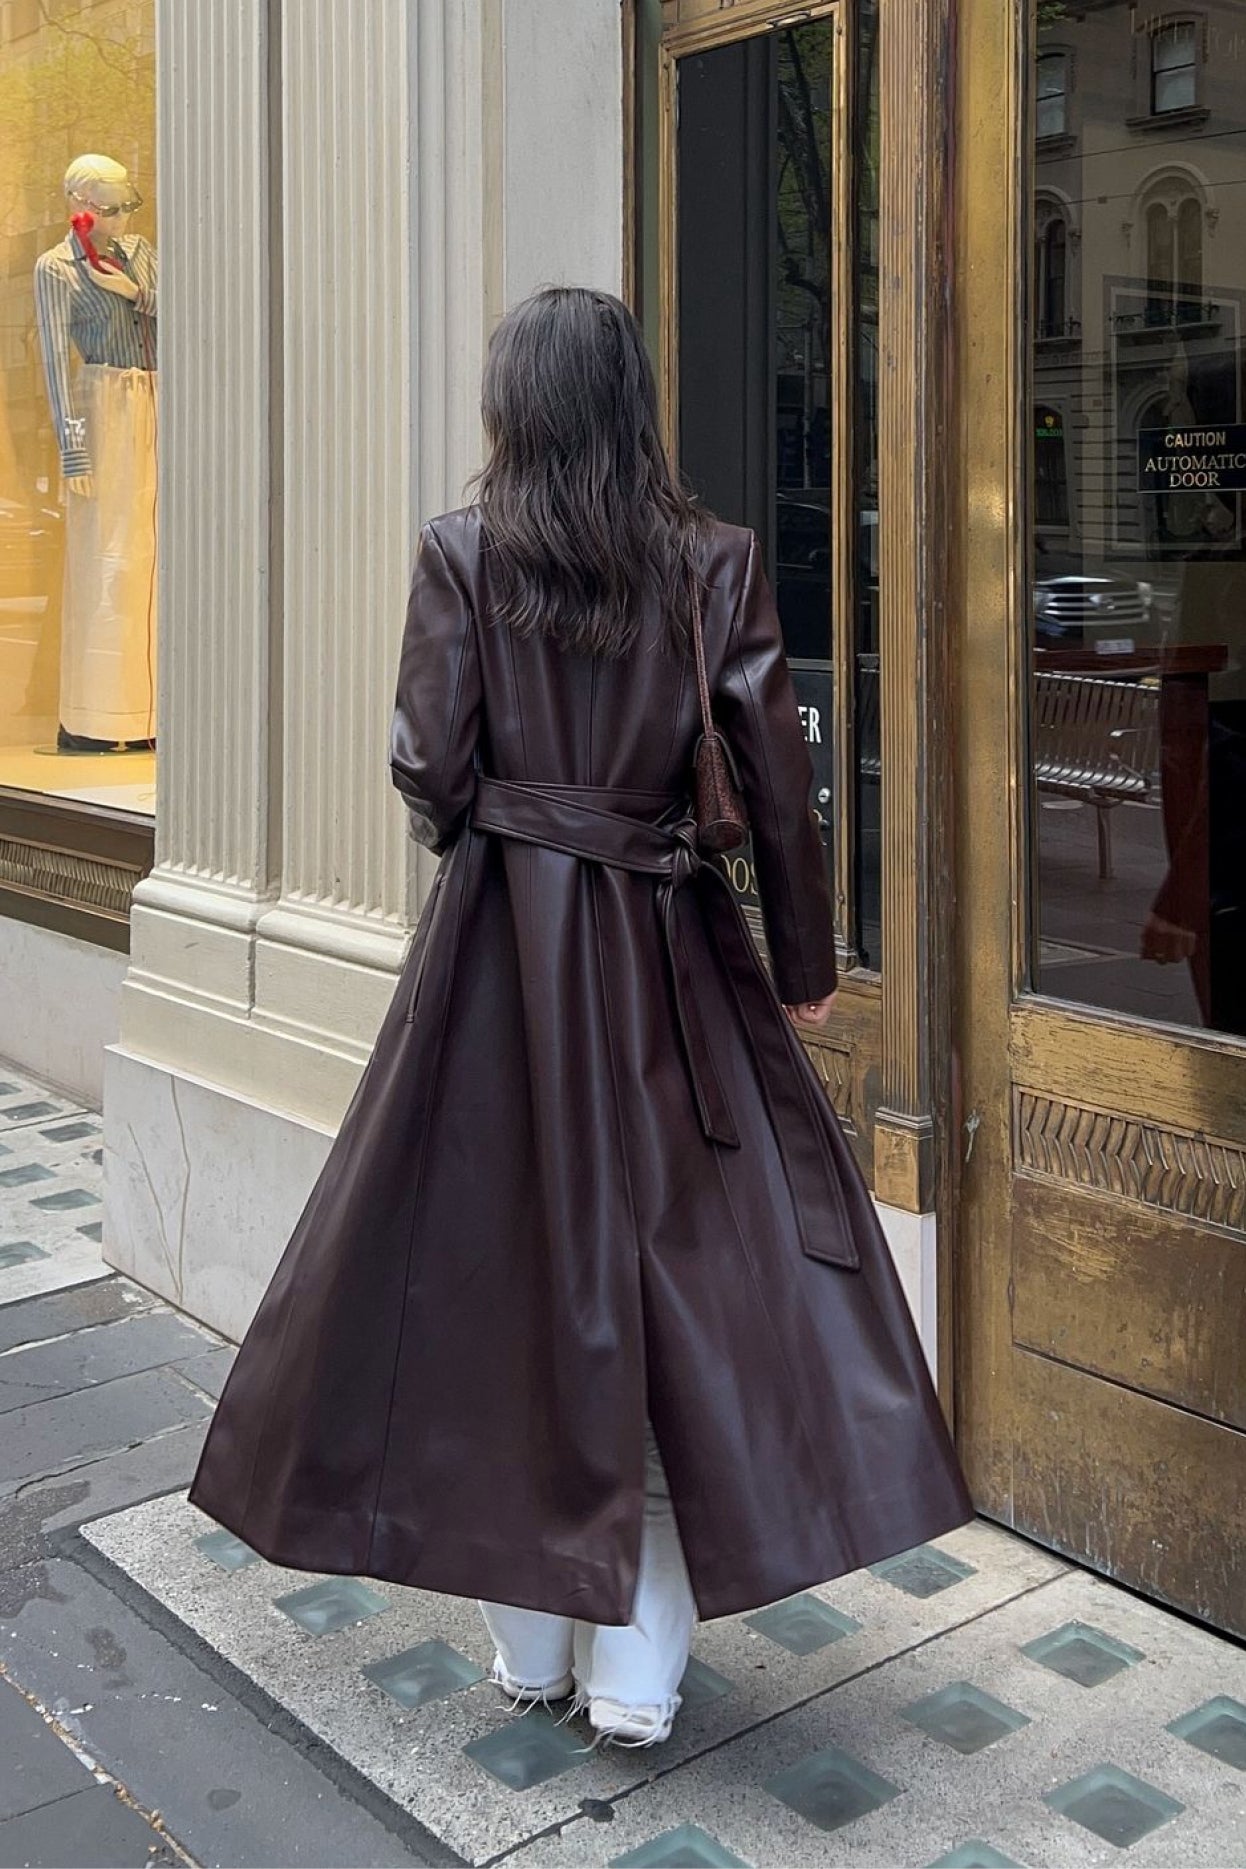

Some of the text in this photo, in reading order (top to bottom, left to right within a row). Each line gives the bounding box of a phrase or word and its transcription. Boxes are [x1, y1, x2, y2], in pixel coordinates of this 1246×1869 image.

[1165, 431, 1226, 448] CAUTION
[1144, 453, 1246, 472] AUTOMATIC
[1169, 471, 1221, 487] DOOR
